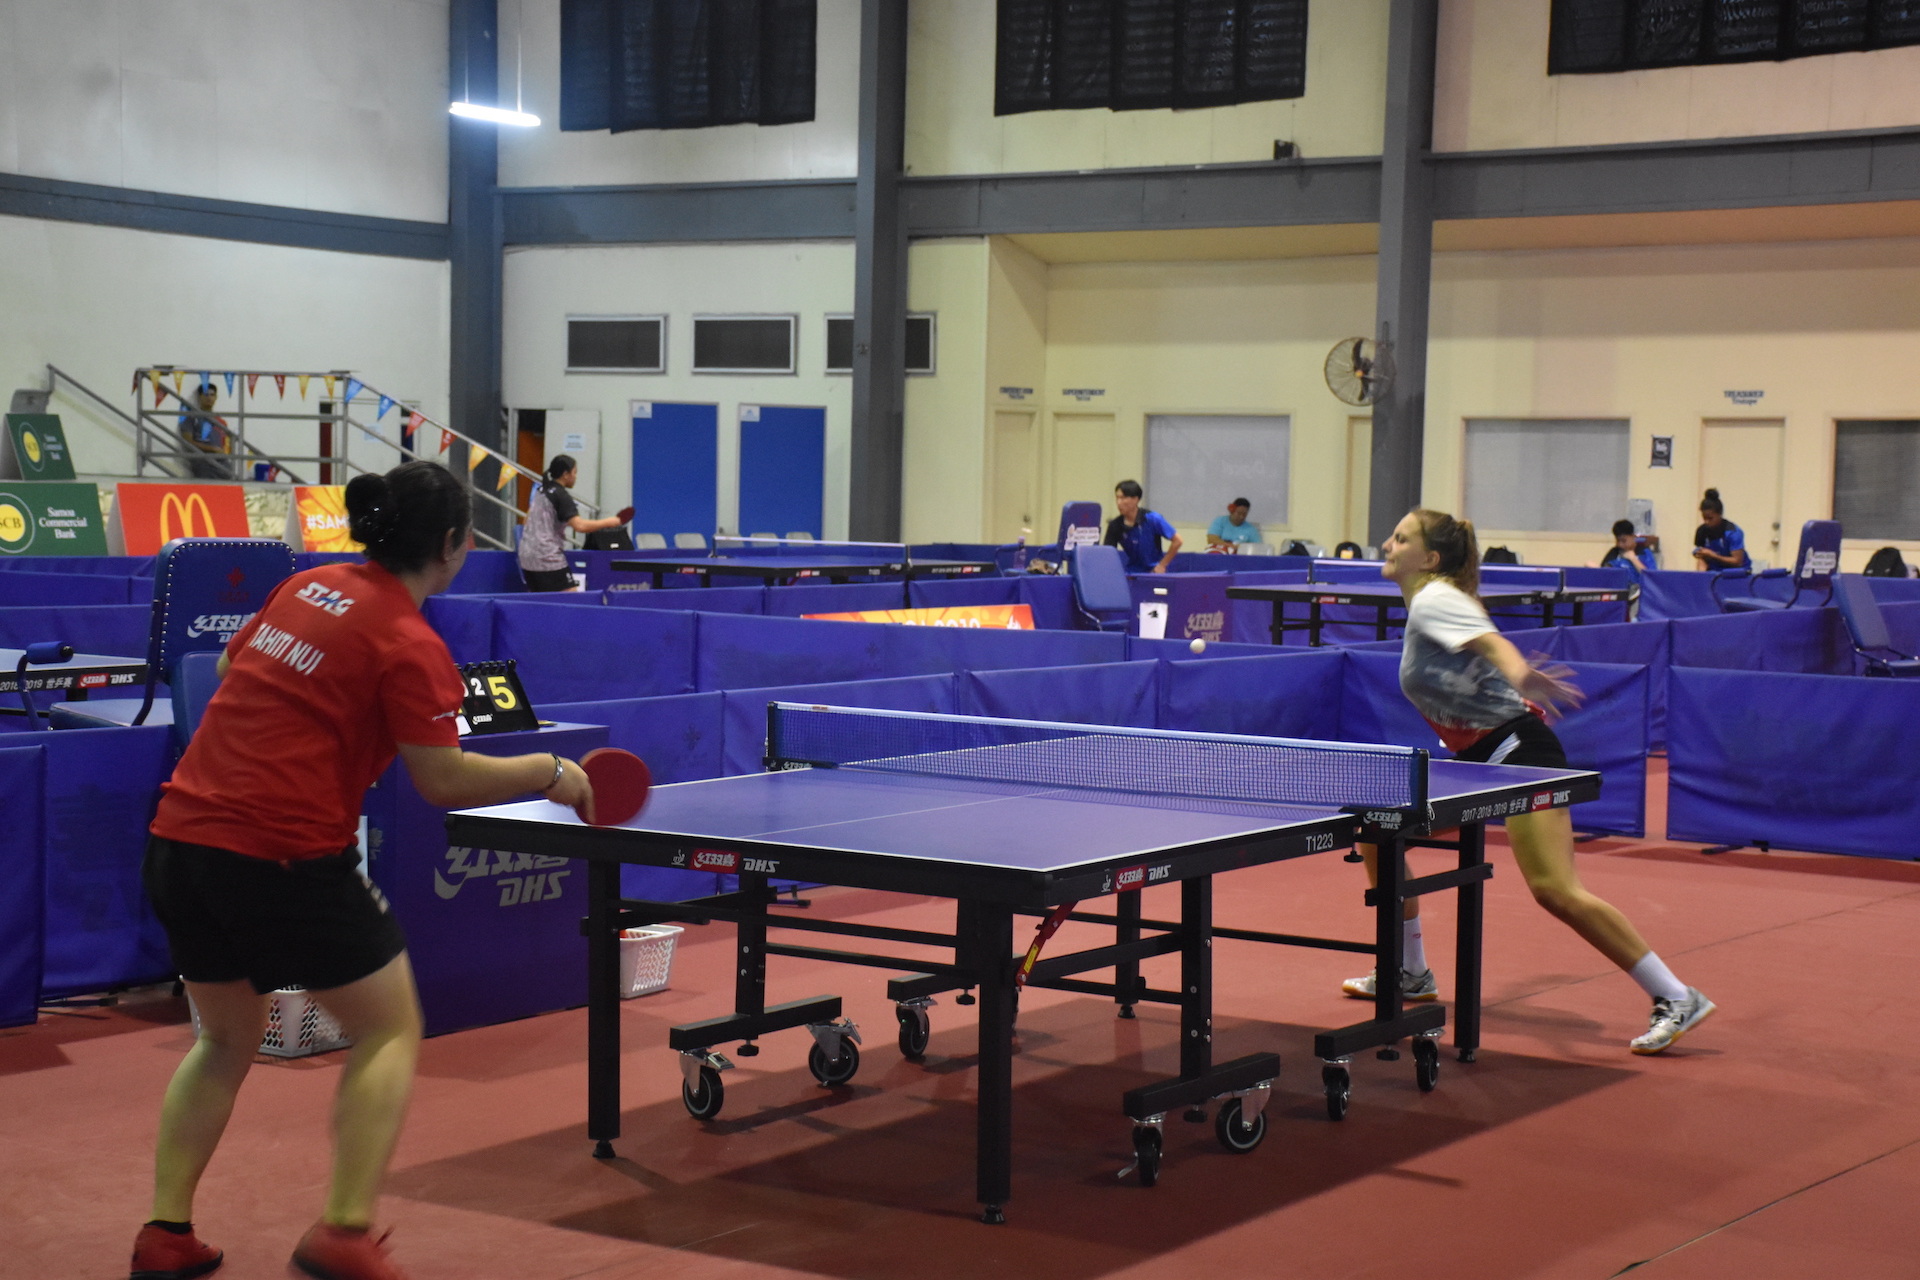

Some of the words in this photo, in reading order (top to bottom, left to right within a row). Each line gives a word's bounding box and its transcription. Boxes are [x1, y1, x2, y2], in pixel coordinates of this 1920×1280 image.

[47, 506, 76, 517] Samoa
[39, 517, 88, 528] Commercial
[54, 528, 77, 539] Bank
[294, 581, 356, 617] STAG
[282, 640, 325, 676] NUI
[110, 673, 136, 684] DHS
[470, 677, 486, 696] 2
[487, 676, 517, 710] 5
[1306, 832, 1334, 852] T1223
[742, 858, 780, 873] DHS
[1148, 864, 1172, 881] DHS
[496, 870, 571, 907] DHS
